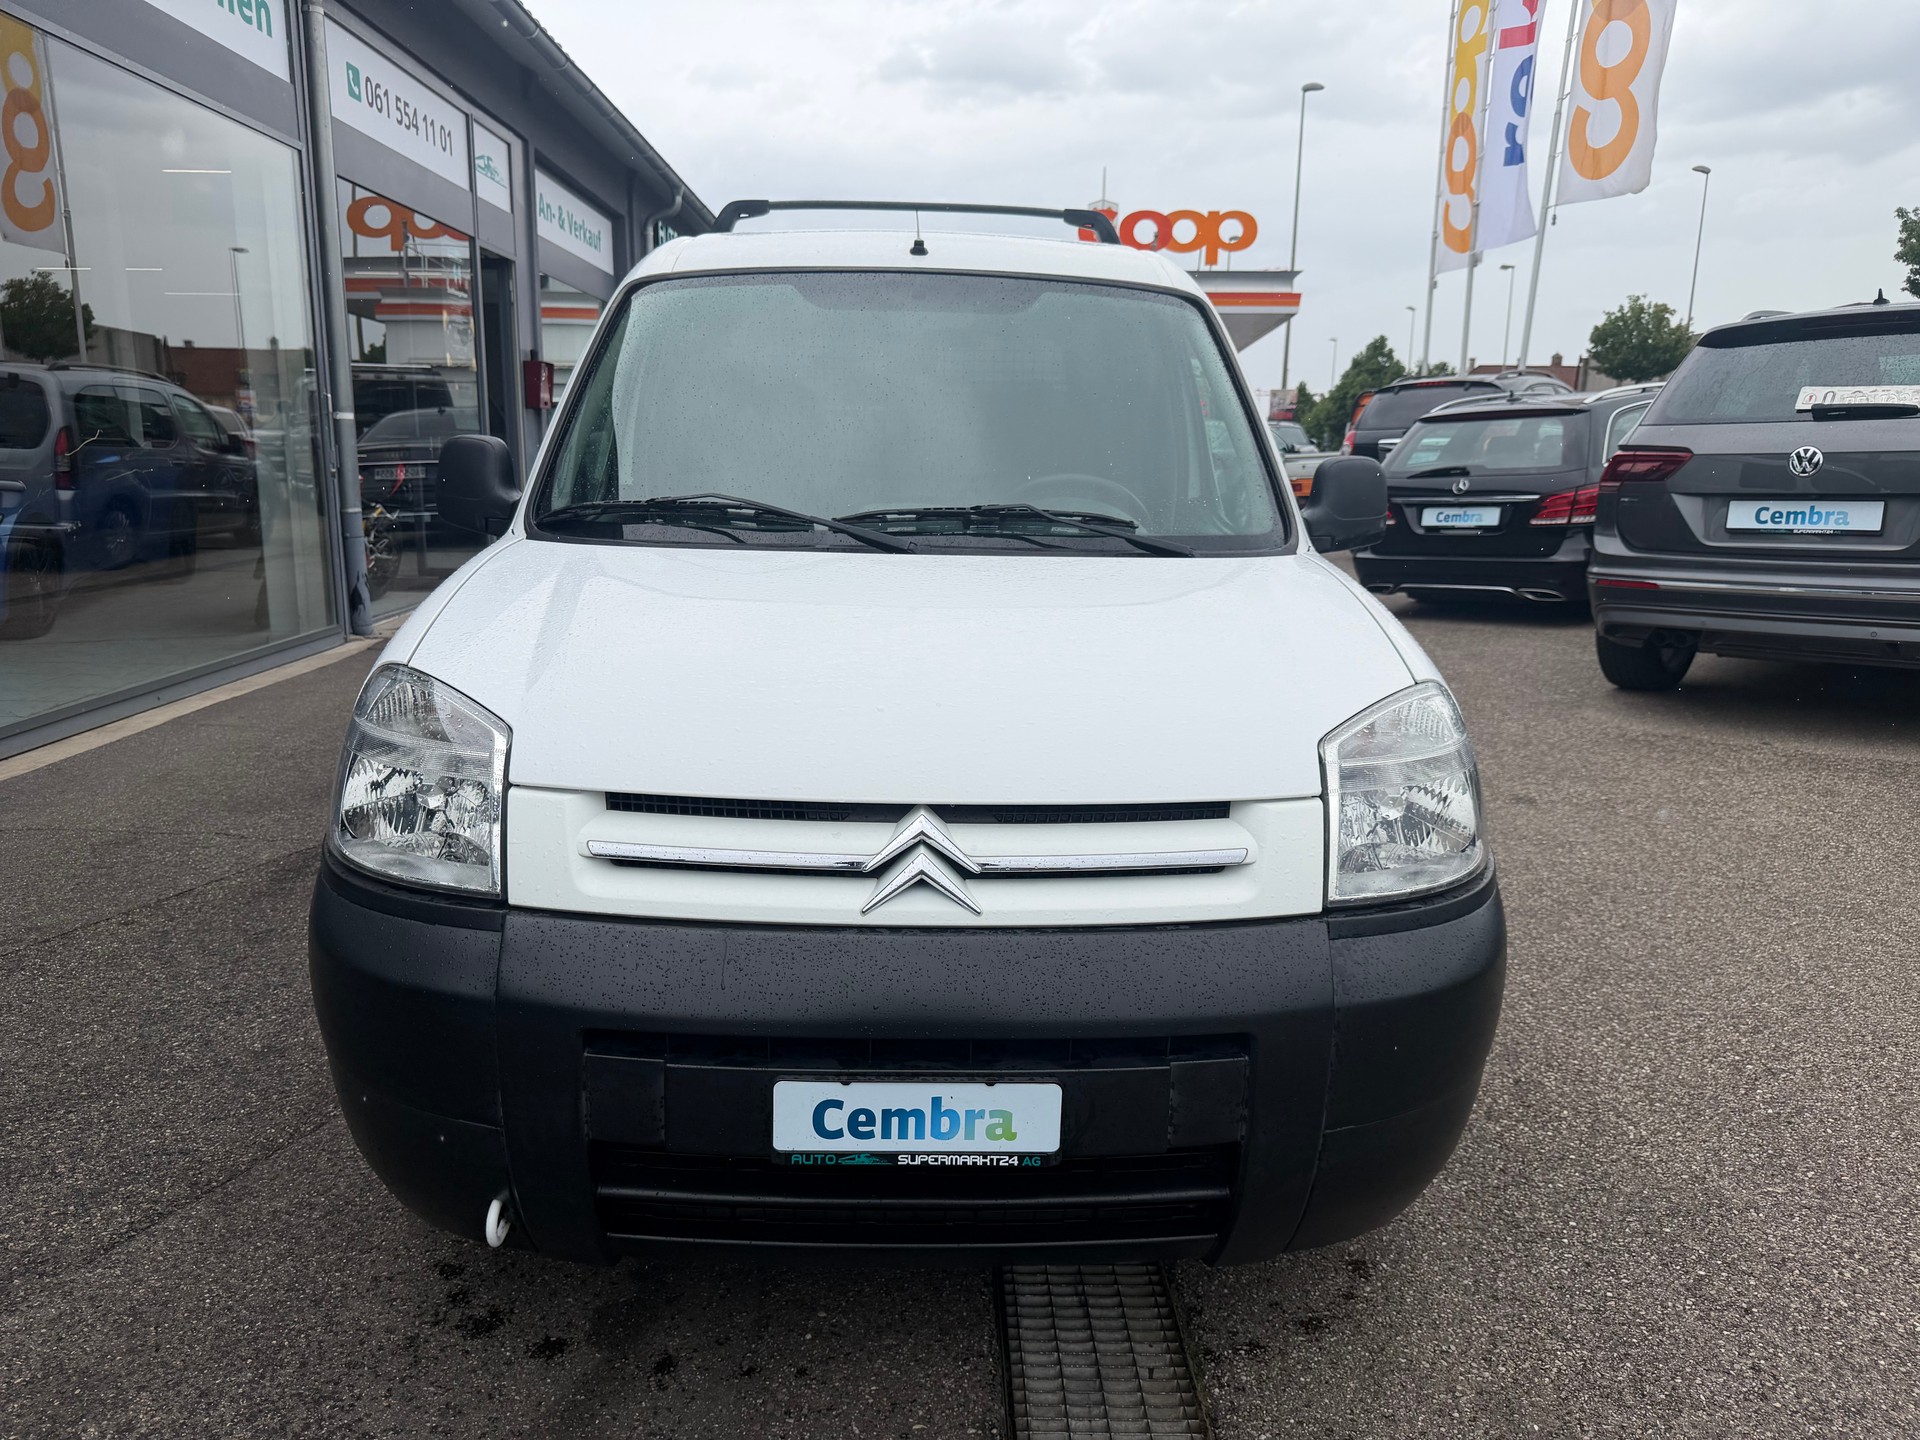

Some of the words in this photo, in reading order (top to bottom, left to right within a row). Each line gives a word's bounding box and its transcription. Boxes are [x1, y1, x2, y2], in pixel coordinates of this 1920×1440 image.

[1568, 0, 1651, 180] co
[365, 76, 391, 119] 061
[395, 94, 419, 136] 554
[422, 114, 436, 147] 11
[440, 124, 453, 157] 01
[538, 192, 556, 223] An-
[558, 205, 566, 232] &
[567, 210, 602, 253] Verkauf
[1436, 510, 1483, 523] Cembra
[1754, 505, 1850, 526] Cembra
[812, 1096, 1018, 1141] Cembra
[791, 1154, 837, 1165] AUTO
[897, 1154, 1019, 1166] SUPERMARKT24
[1022, 1156, 1041, 1166] AG
